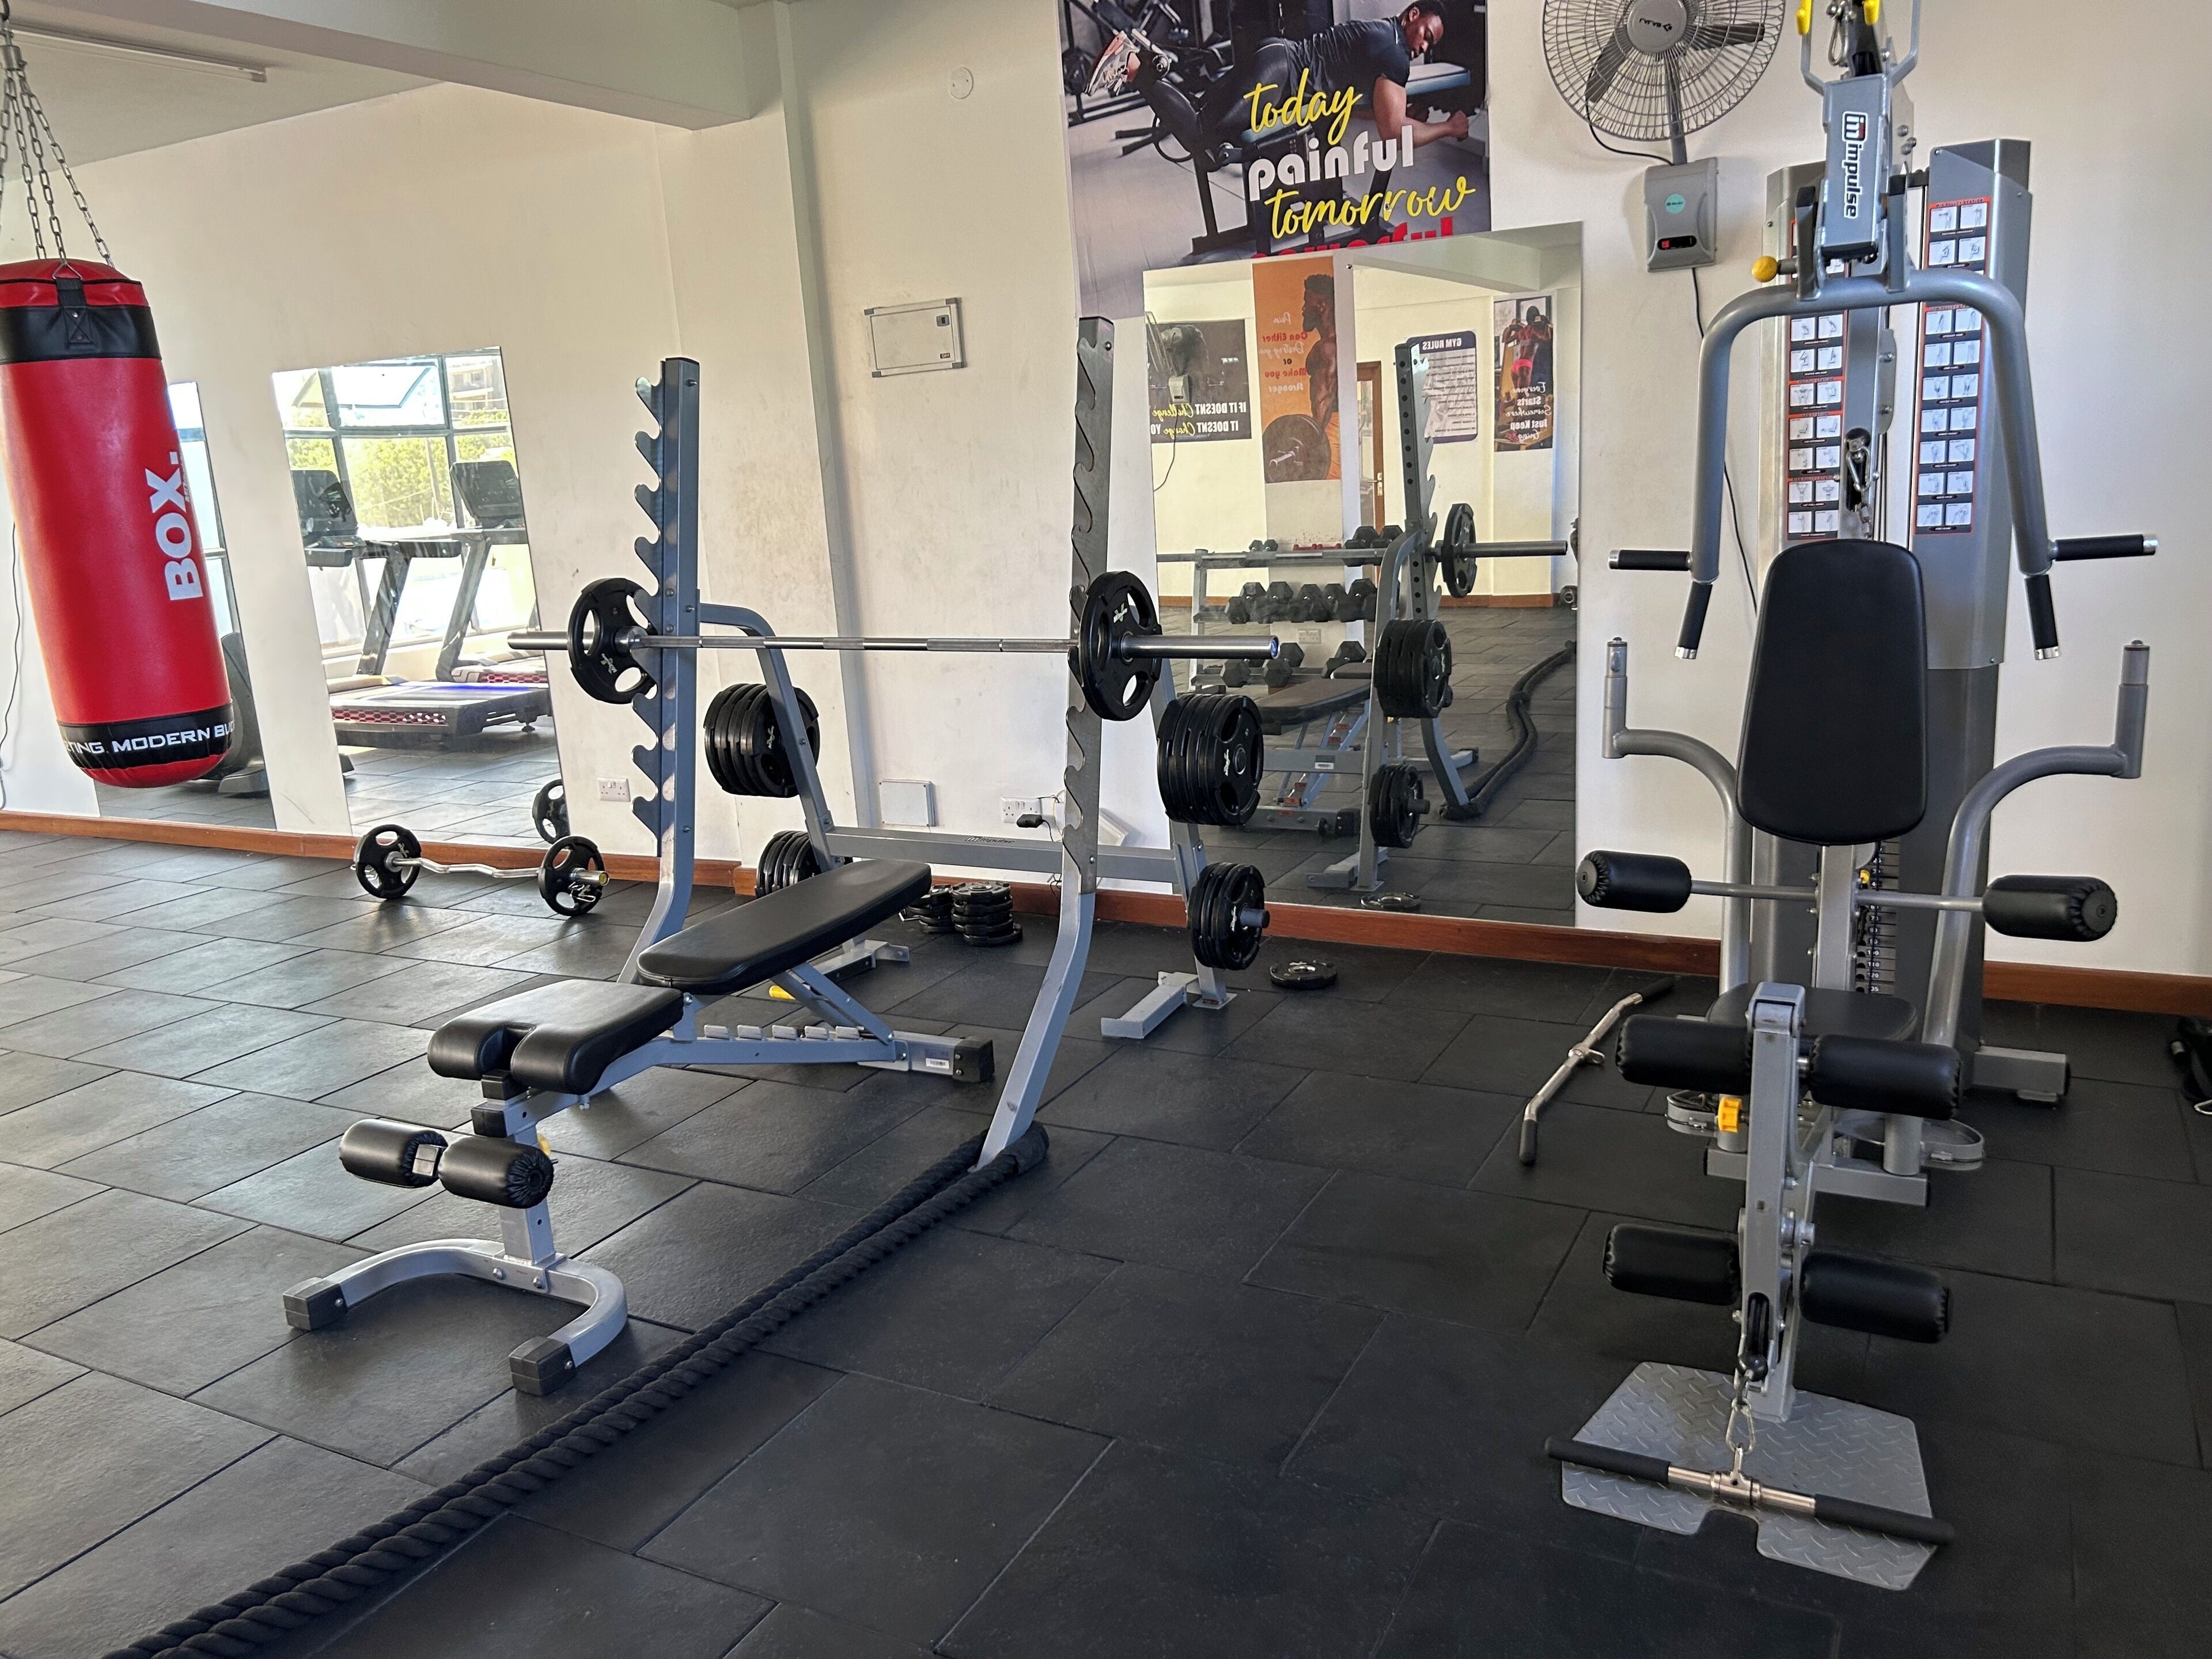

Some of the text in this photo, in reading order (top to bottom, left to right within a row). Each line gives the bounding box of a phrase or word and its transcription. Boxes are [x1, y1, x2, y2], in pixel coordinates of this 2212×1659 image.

[1243, 67, 1362, 144] today
[1248, 125, 1414, 201] painful
[1264, 176, 1476, 239] tomorrow
[111, 727, 210, 753] MODERN
